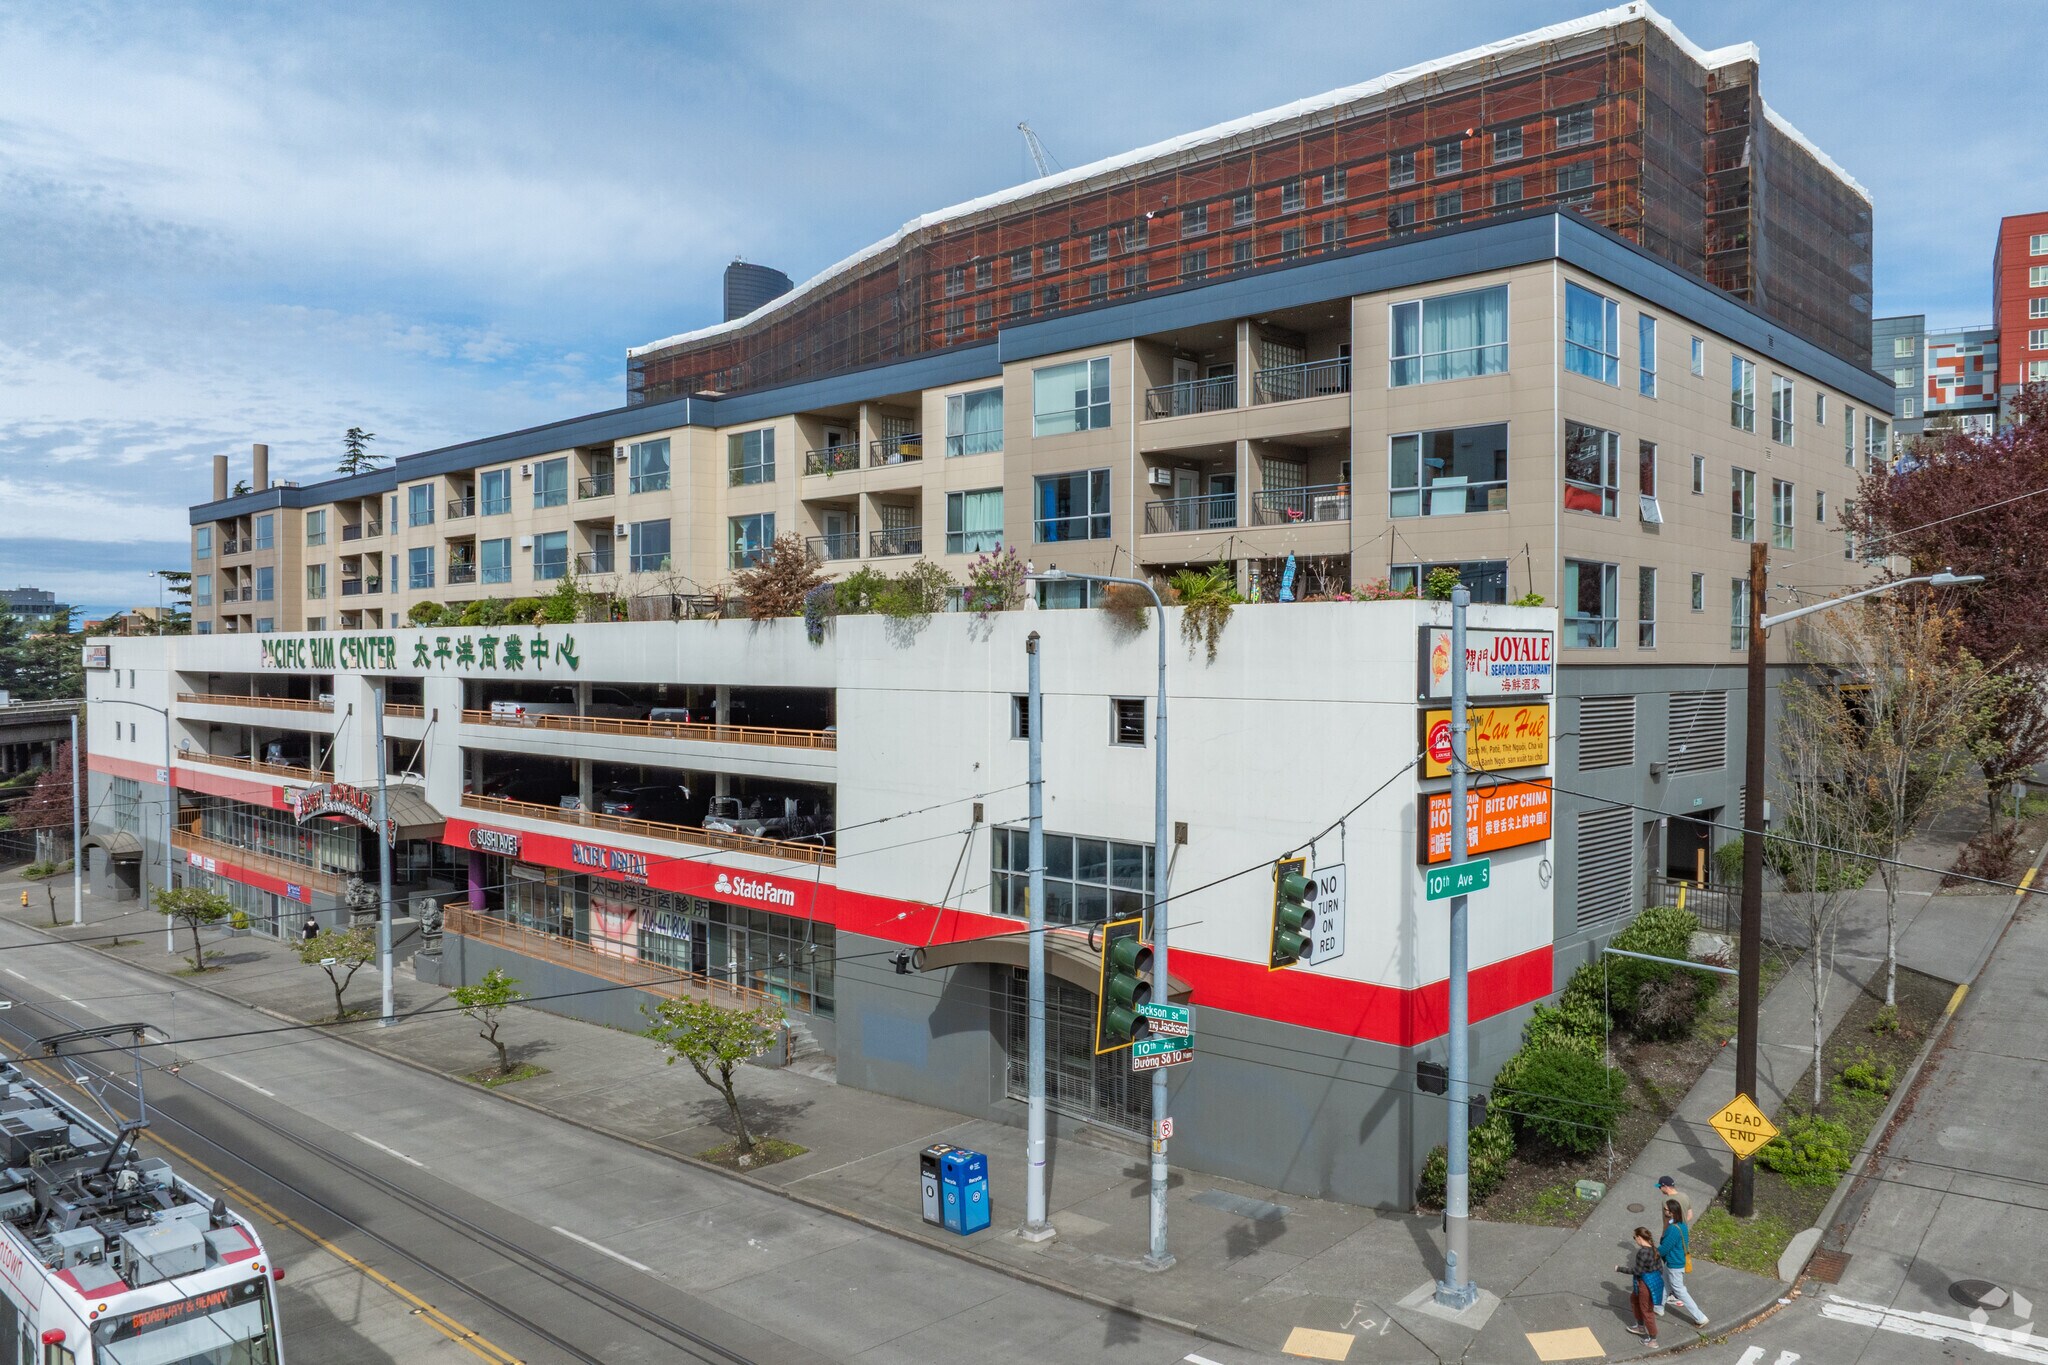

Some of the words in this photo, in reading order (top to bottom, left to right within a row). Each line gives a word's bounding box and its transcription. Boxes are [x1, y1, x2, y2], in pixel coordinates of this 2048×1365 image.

[261, 638, 307, 669] PACIFIC
[309, 637, 336, 669] RIM
[340, 636, 397, 670] CENTER
[412, 632, 580, 672] 太平洋商業中心
[1490, 636, 1551, 662] JOYALE
[1491, 664, 1516, 676] SEAFOOD
[1517, 663, 1551, 675] RESTAURANT
[1478, 709, 1509, 741] Lan
[1431, 799, 1446, 809] PIPA
[1485, 797, 1505, 814] BITE
[1506, 795, 1519, 810] OF
[1520, 790, 1547, 808] CHINA
[572, 843, 608, 869] PACIFIC
[610, 850, 648, 877] DENTAL
[1320, 875, 1337, 896] NO
[1429, 875, 1450, 895] 10th
[1457, 873, 1473, 888] Ave
[1482, 868, 1488, 882] S
[1318, 898, 1339, 916] TURN
[1322, 918, 1334, 933] ON
[1320, 936, 1336, 953] RED
[1137, 1003, 1167, 1018] Jackson
[1171, 1012, 1179, 1020] St
[1159, 1020, 1188, 1035] Jackson
[1138, 1042, 1157, 1055] 10th
[1163, 1042, 1175, 1050] Ave
[1183, 1038, 1188, 1046] S
[1172, 1051, 1181, 1063] 10
[1725, 1111, 1761, 1127] DEAD
[1730, 1129, 1756, 1142] END
[132, 1302, 185, 1328] BROADWAY
[186, 1301, 195, 1313] &
